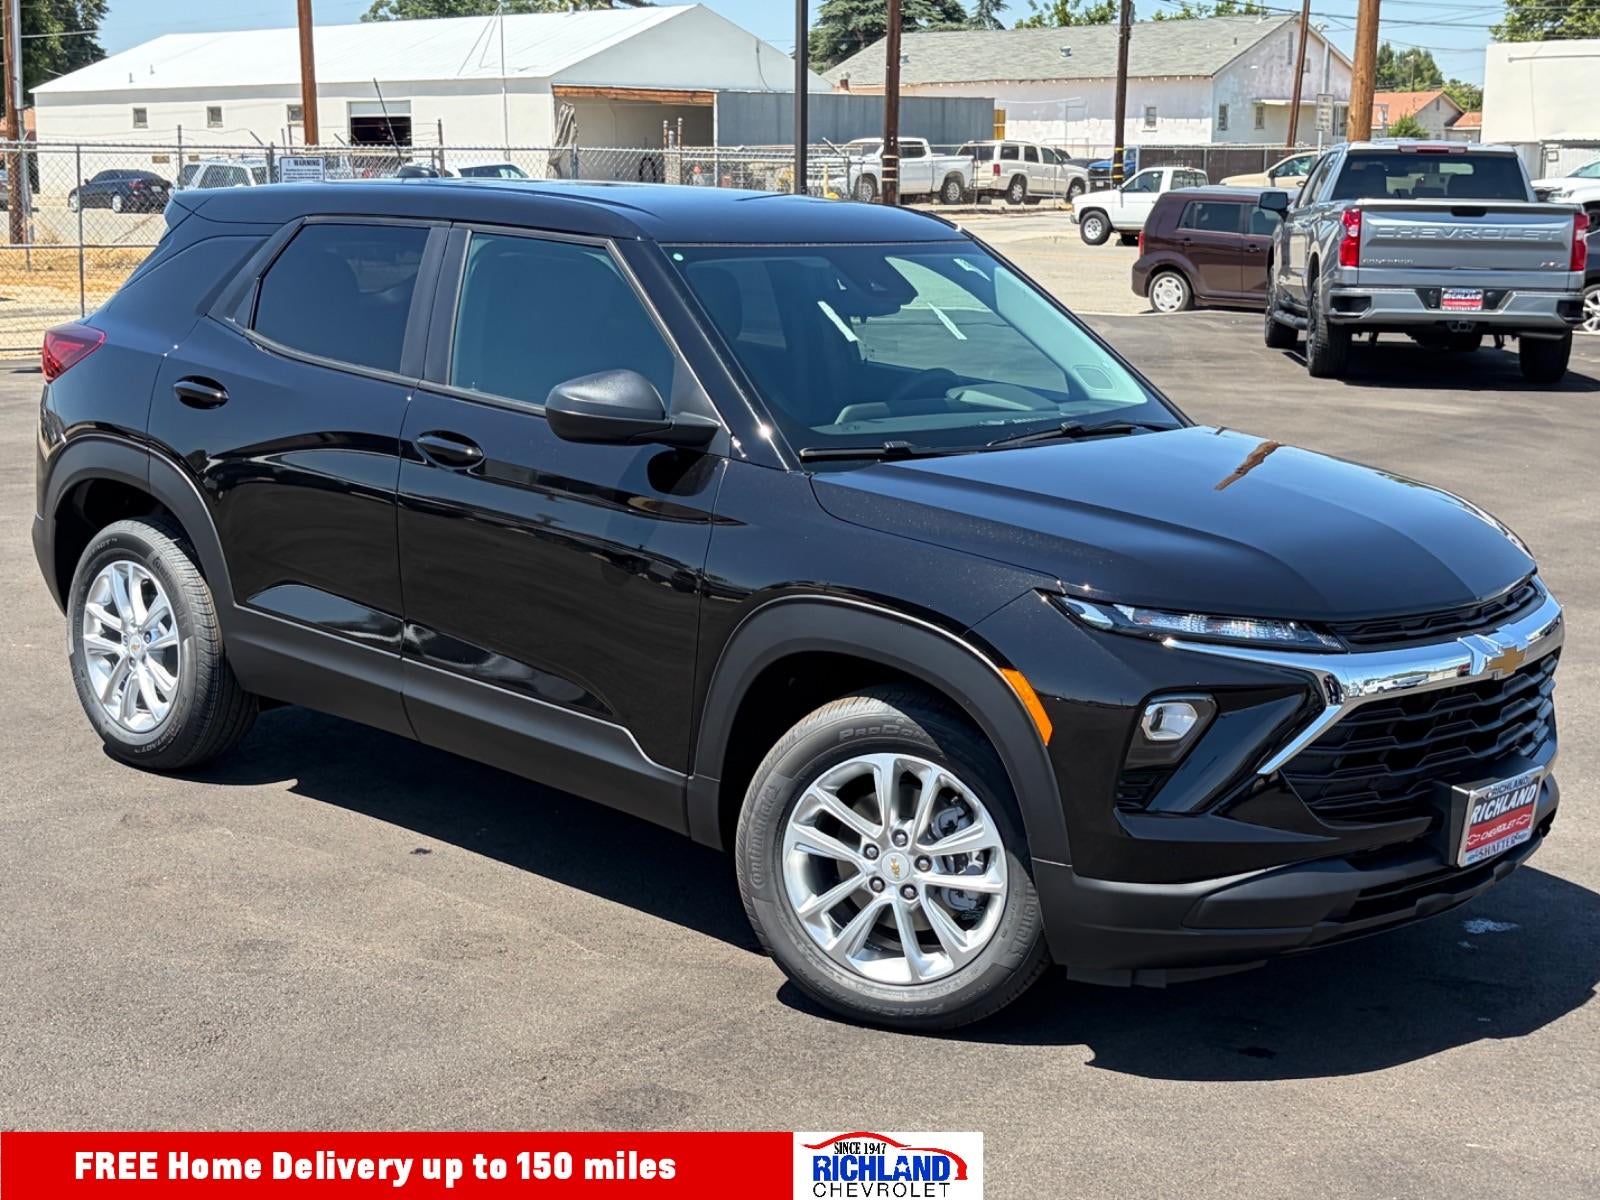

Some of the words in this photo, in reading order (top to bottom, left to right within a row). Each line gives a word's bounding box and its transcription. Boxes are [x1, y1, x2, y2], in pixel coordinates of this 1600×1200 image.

[293, 159, 320, 167] WARNING
[1375, 226, 1561, 241] CHEVROLET
[1470, 783, 1537, 824] RICHLAND
